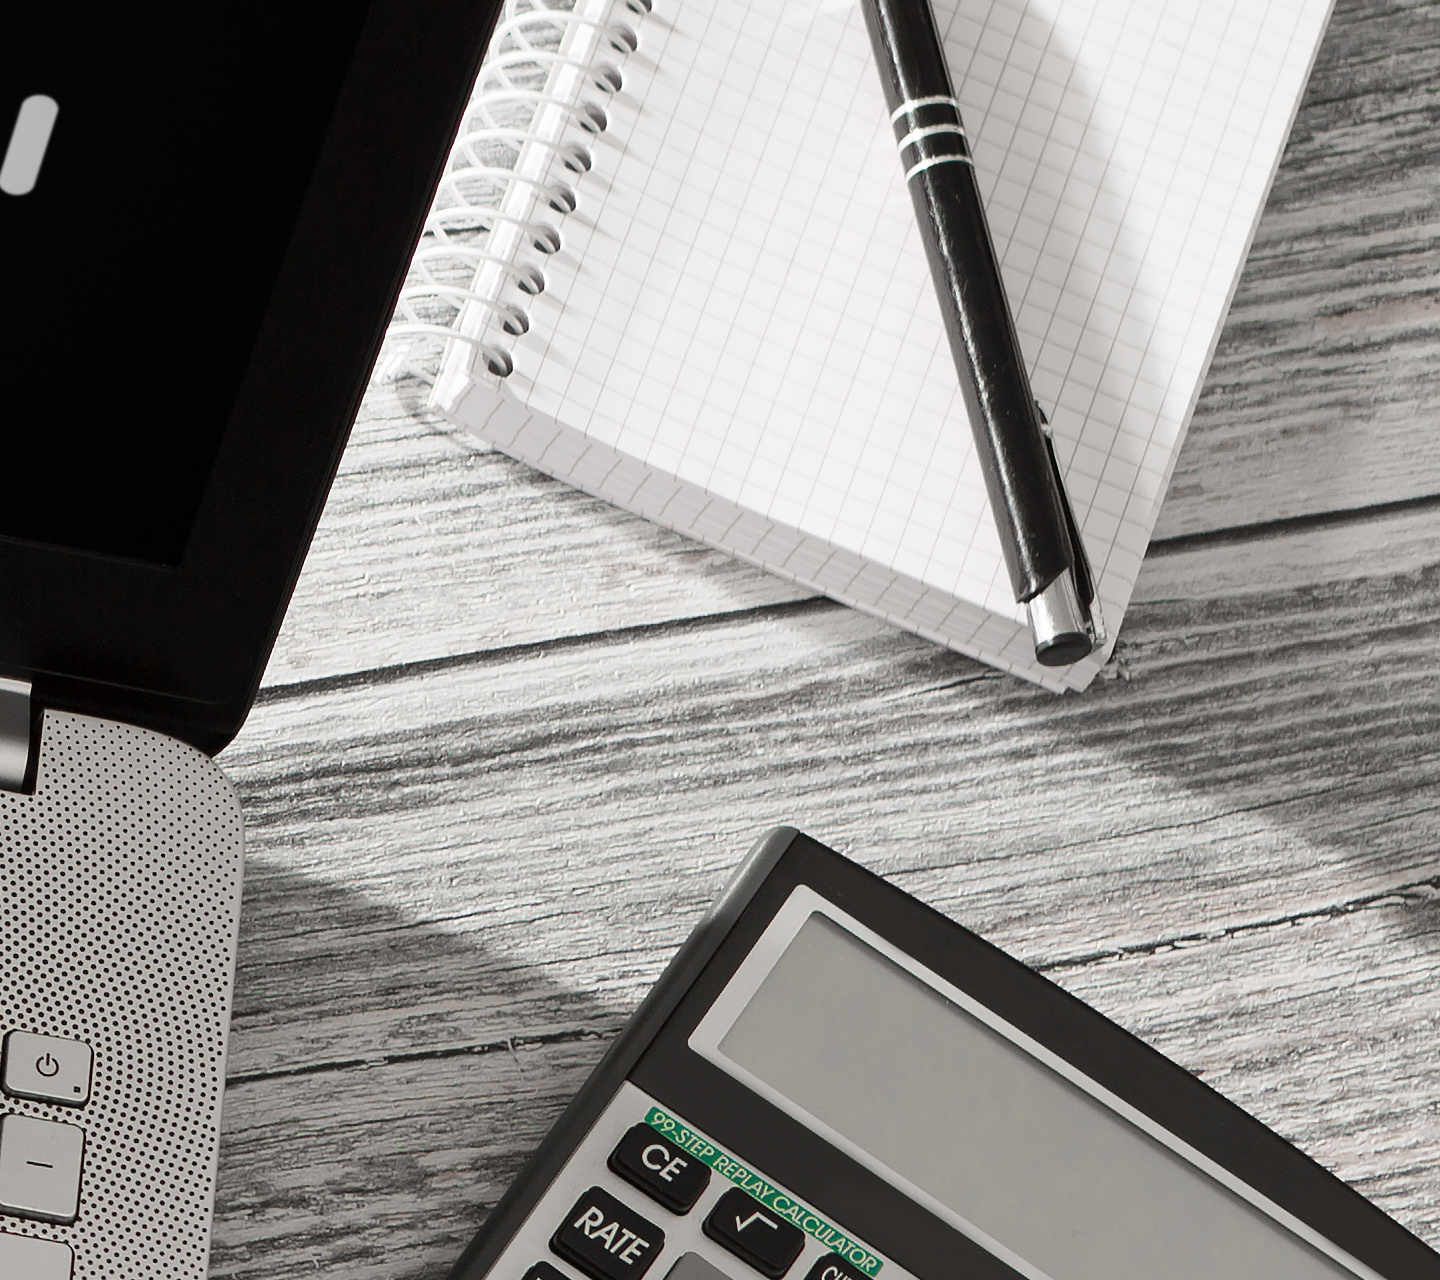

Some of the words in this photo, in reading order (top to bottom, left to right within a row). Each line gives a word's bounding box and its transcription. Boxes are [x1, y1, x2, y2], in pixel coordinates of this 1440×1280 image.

[642, 1145, 689, 1181] CE
[652, 1111, 715, 1158] 99-STEP
[712, 1155, 776, 1202] REPLAY
[773, 1195, 877, 1272] CALCULATOR
[574, 1207, 649, 1264] RATE
